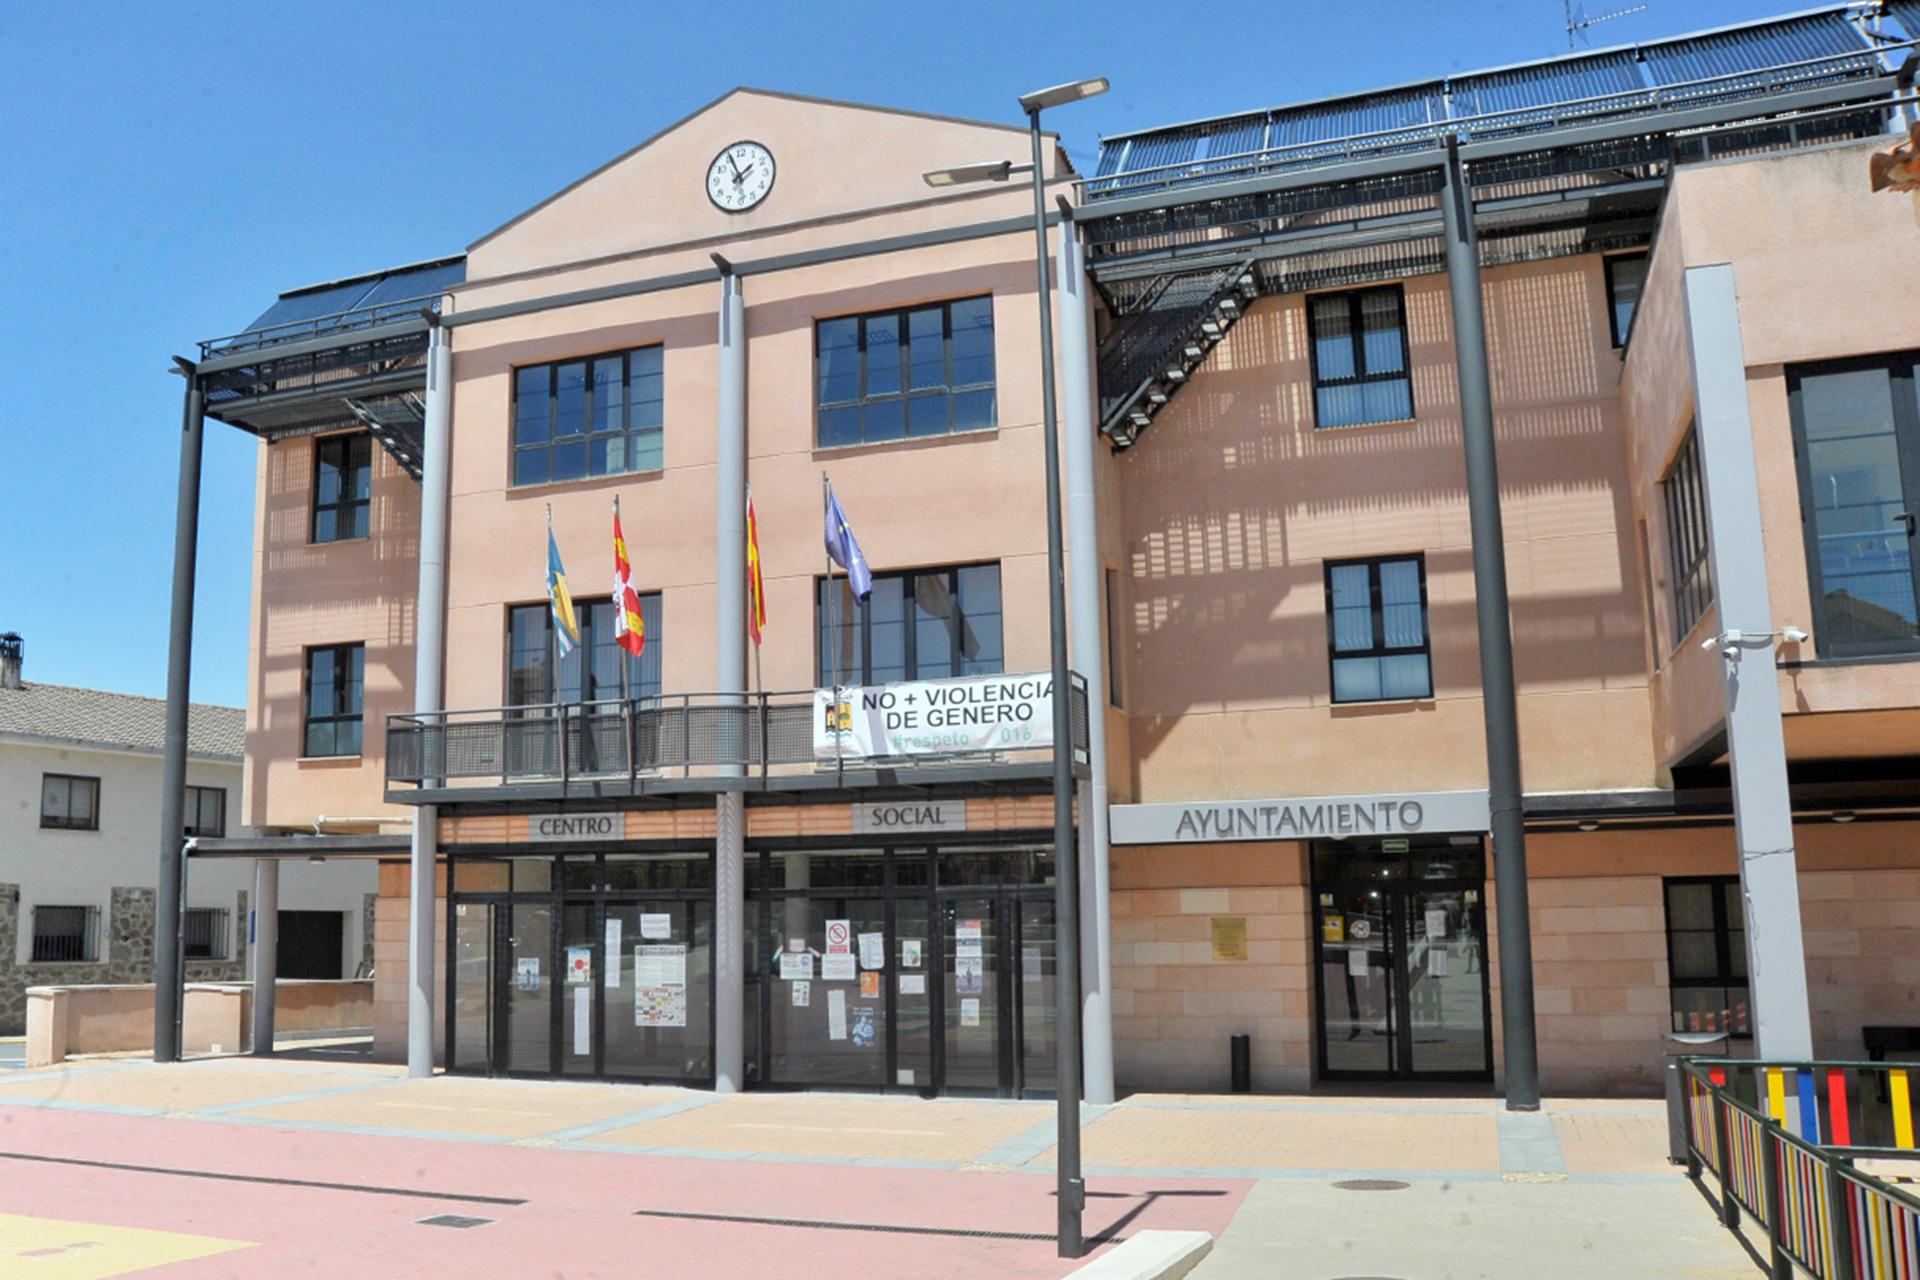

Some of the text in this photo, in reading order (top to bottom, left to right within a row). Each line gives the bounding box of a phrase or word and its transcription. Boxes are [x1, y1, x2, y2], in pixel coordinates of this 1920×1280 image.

[736, 148, 746, 158] 12
[751, 150, 756, 158] 1
[759, 157, 766, 165] 2
[717, 165, 727, 174] 10
[762, 168, 769, 177] 3
[713, 177, 720, 186] 9
[758, 180, 764, 189] 4
[717, 188, 724, 197] 8
[749, 191, 756, 200] 5
[726, 195, 732, 204] 7
[737, 196, 744, 205] 6
[862, 692, 896, 711] NO
[904, 694, 917, 706] +
[886, 703, 1033, 730] DE GENERO
[893, 726, 1032, 750] #respeto 016
[871, 806, 946, 827] SOCIAL
[1175, 800, 1424, 838] AYUNTAMIENTO
[539, 817, 612, 836] CENTRO
